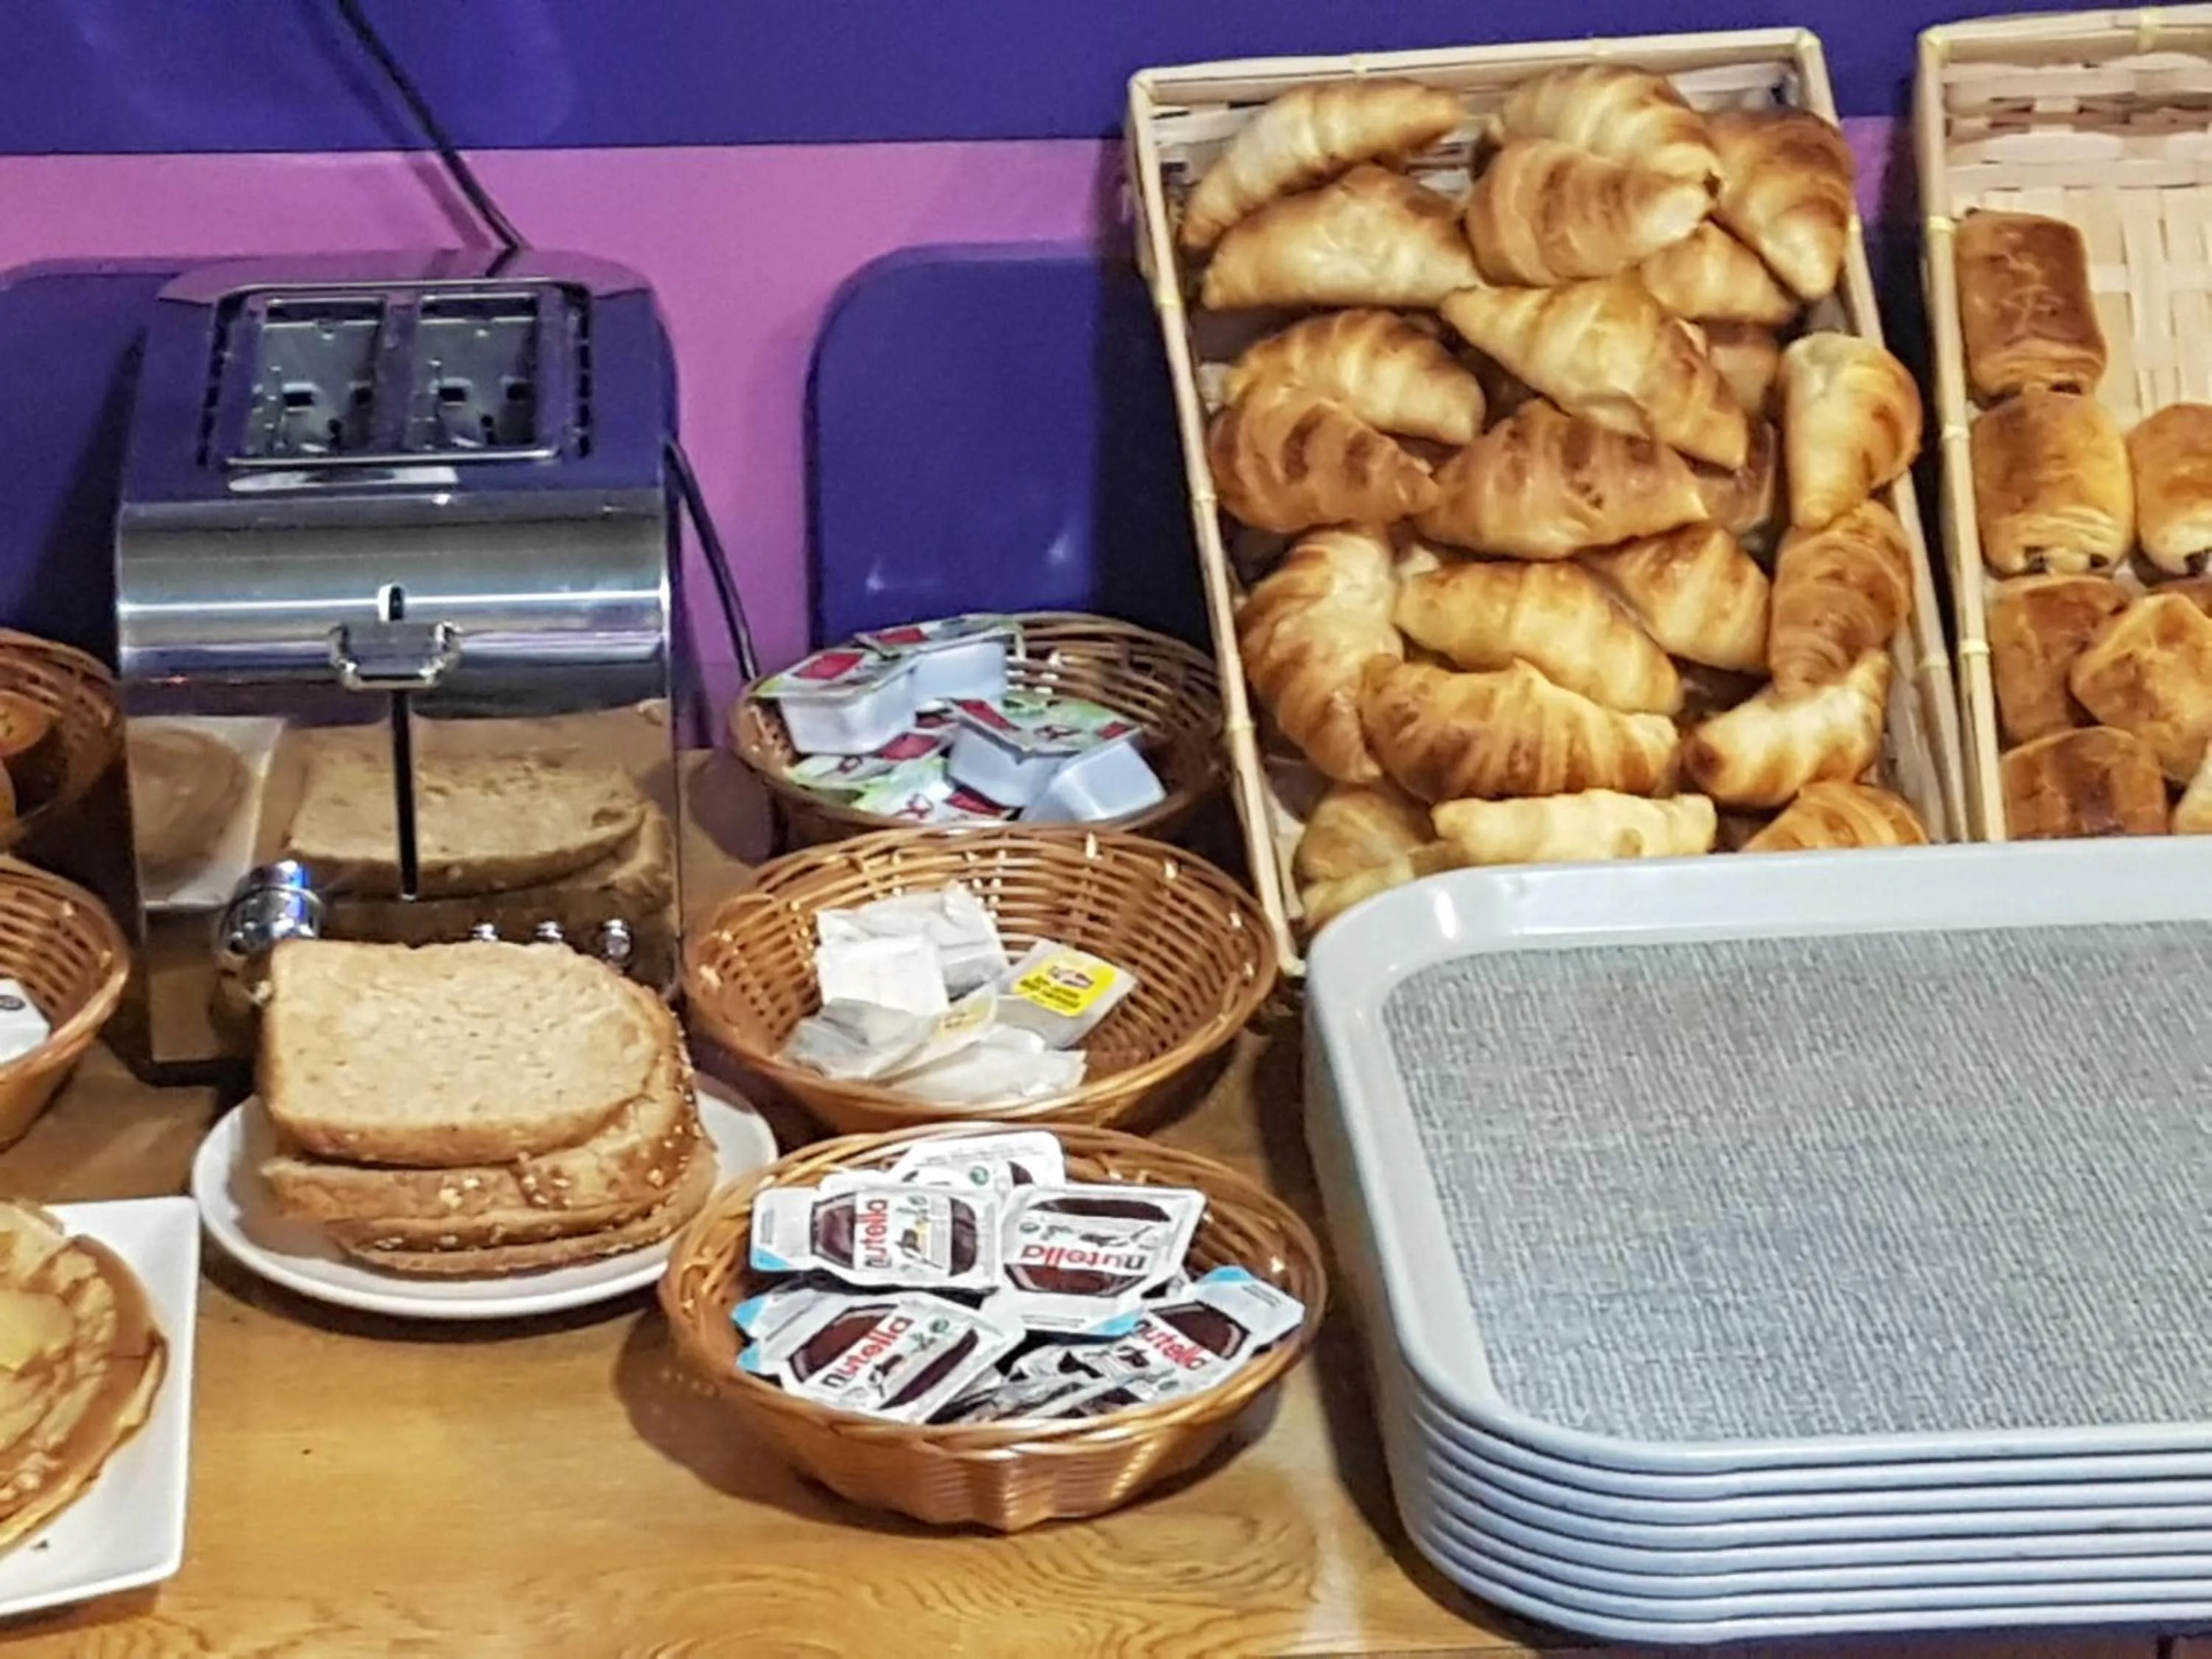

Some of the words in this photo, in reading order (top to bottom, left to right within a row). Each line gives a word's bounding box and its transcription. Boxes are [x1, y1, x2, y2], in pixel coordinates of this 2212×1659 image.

[858, 1197, 891, 1268] nutella
[1020, 1244, 1147, 1270] nutella
[821, 1316, 916, 1388] nutella
